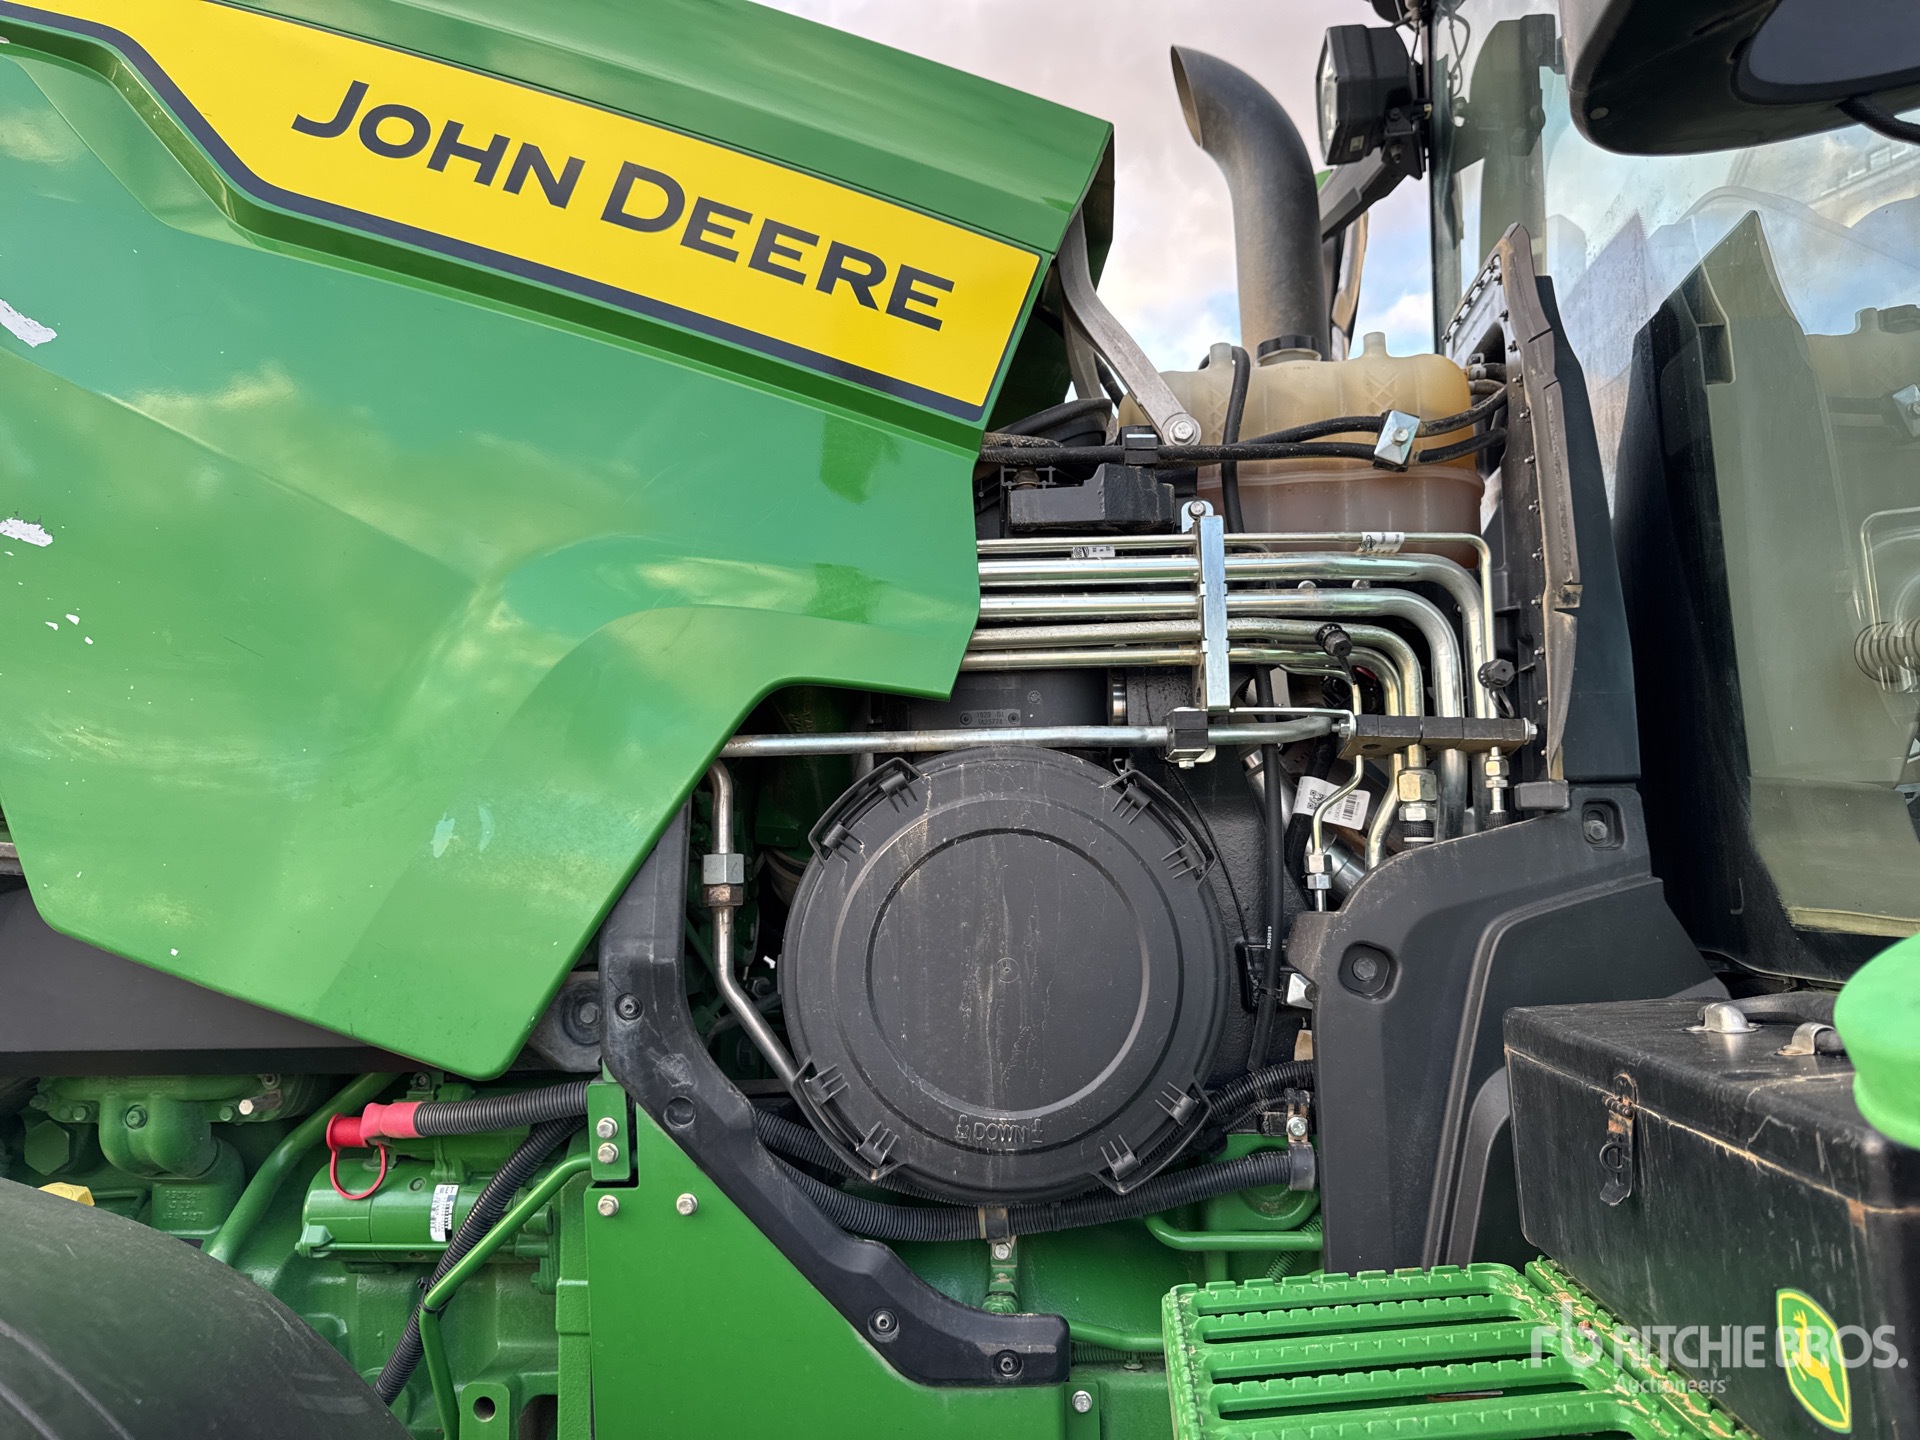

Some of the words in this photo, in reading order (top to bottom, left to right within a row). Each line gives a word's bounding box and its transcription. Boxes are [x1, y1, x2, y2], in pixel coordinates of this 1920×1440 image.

[291, 80, 586, 210] JOHN
[600, 160, 955, 332] DEERE
[974, 1122, 1030, 1143] DOWN
